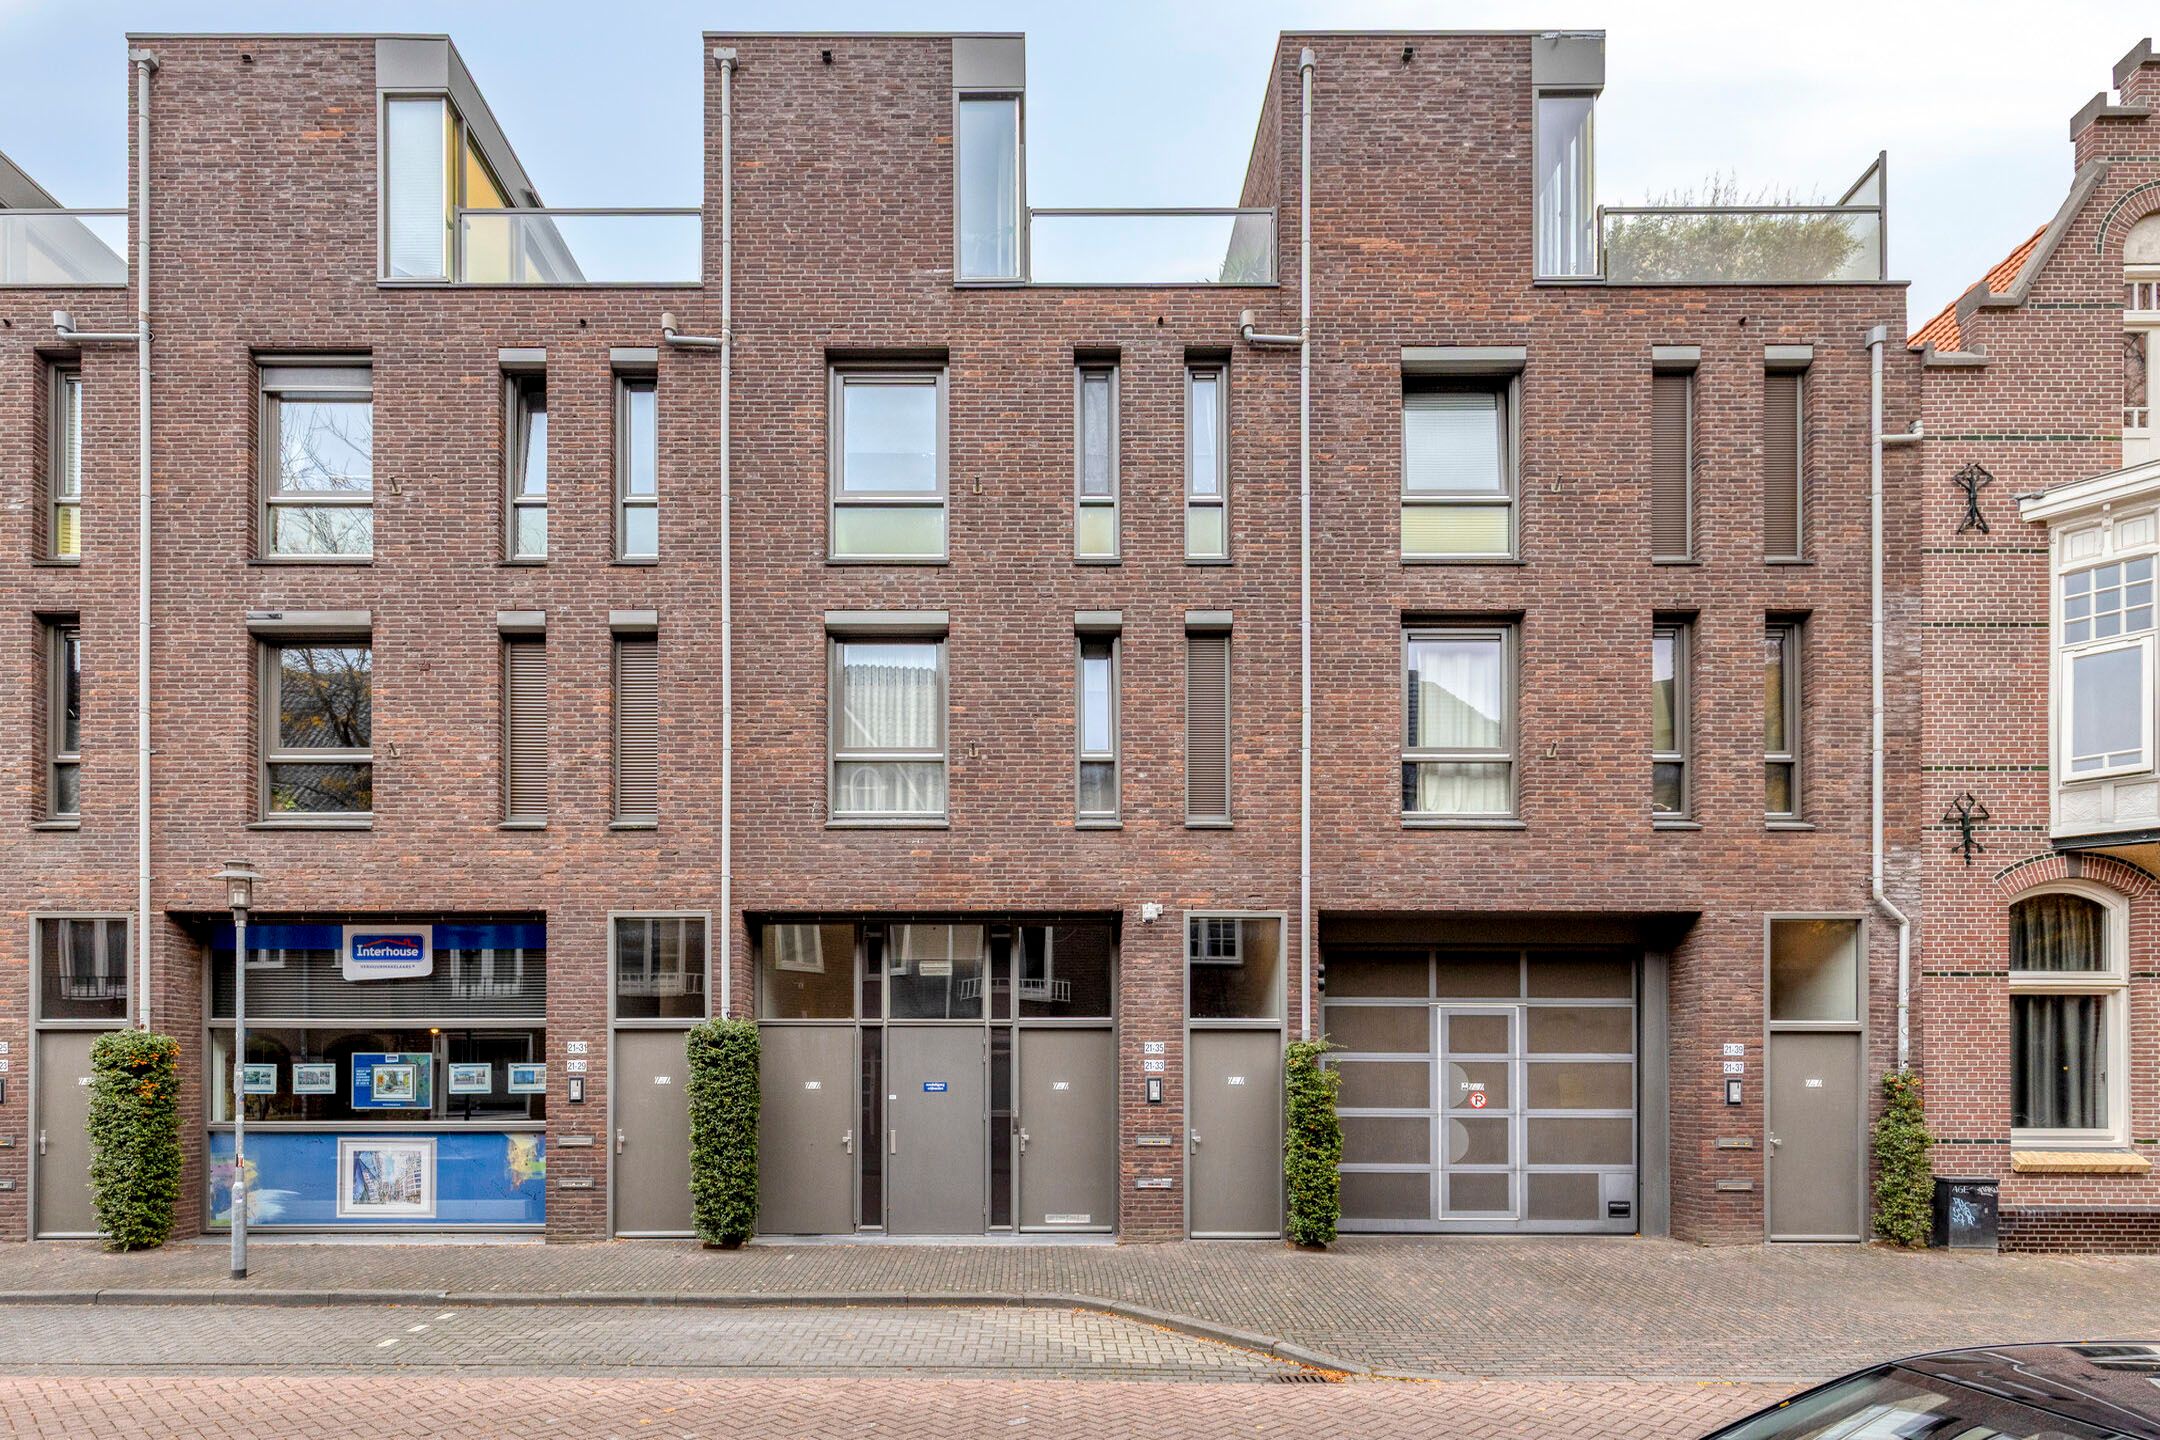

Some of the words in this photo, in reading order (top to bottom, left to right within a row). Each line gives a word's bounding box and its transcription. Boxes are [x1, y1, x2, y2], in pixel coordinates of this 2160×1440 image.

[357, 944, 419, 957] Interhouse
[568, 1043, 587, 1052] 21-31
[1145, 1043, 1164, 1052] 21-35
[1725, 1045, 1743, 1054] 21-39
[567, 1061, 587, 1070] 21-29
[1145, 1061, 1164, 1070] 21-33
[1725, 1063, 1743, 1072] 21-37
